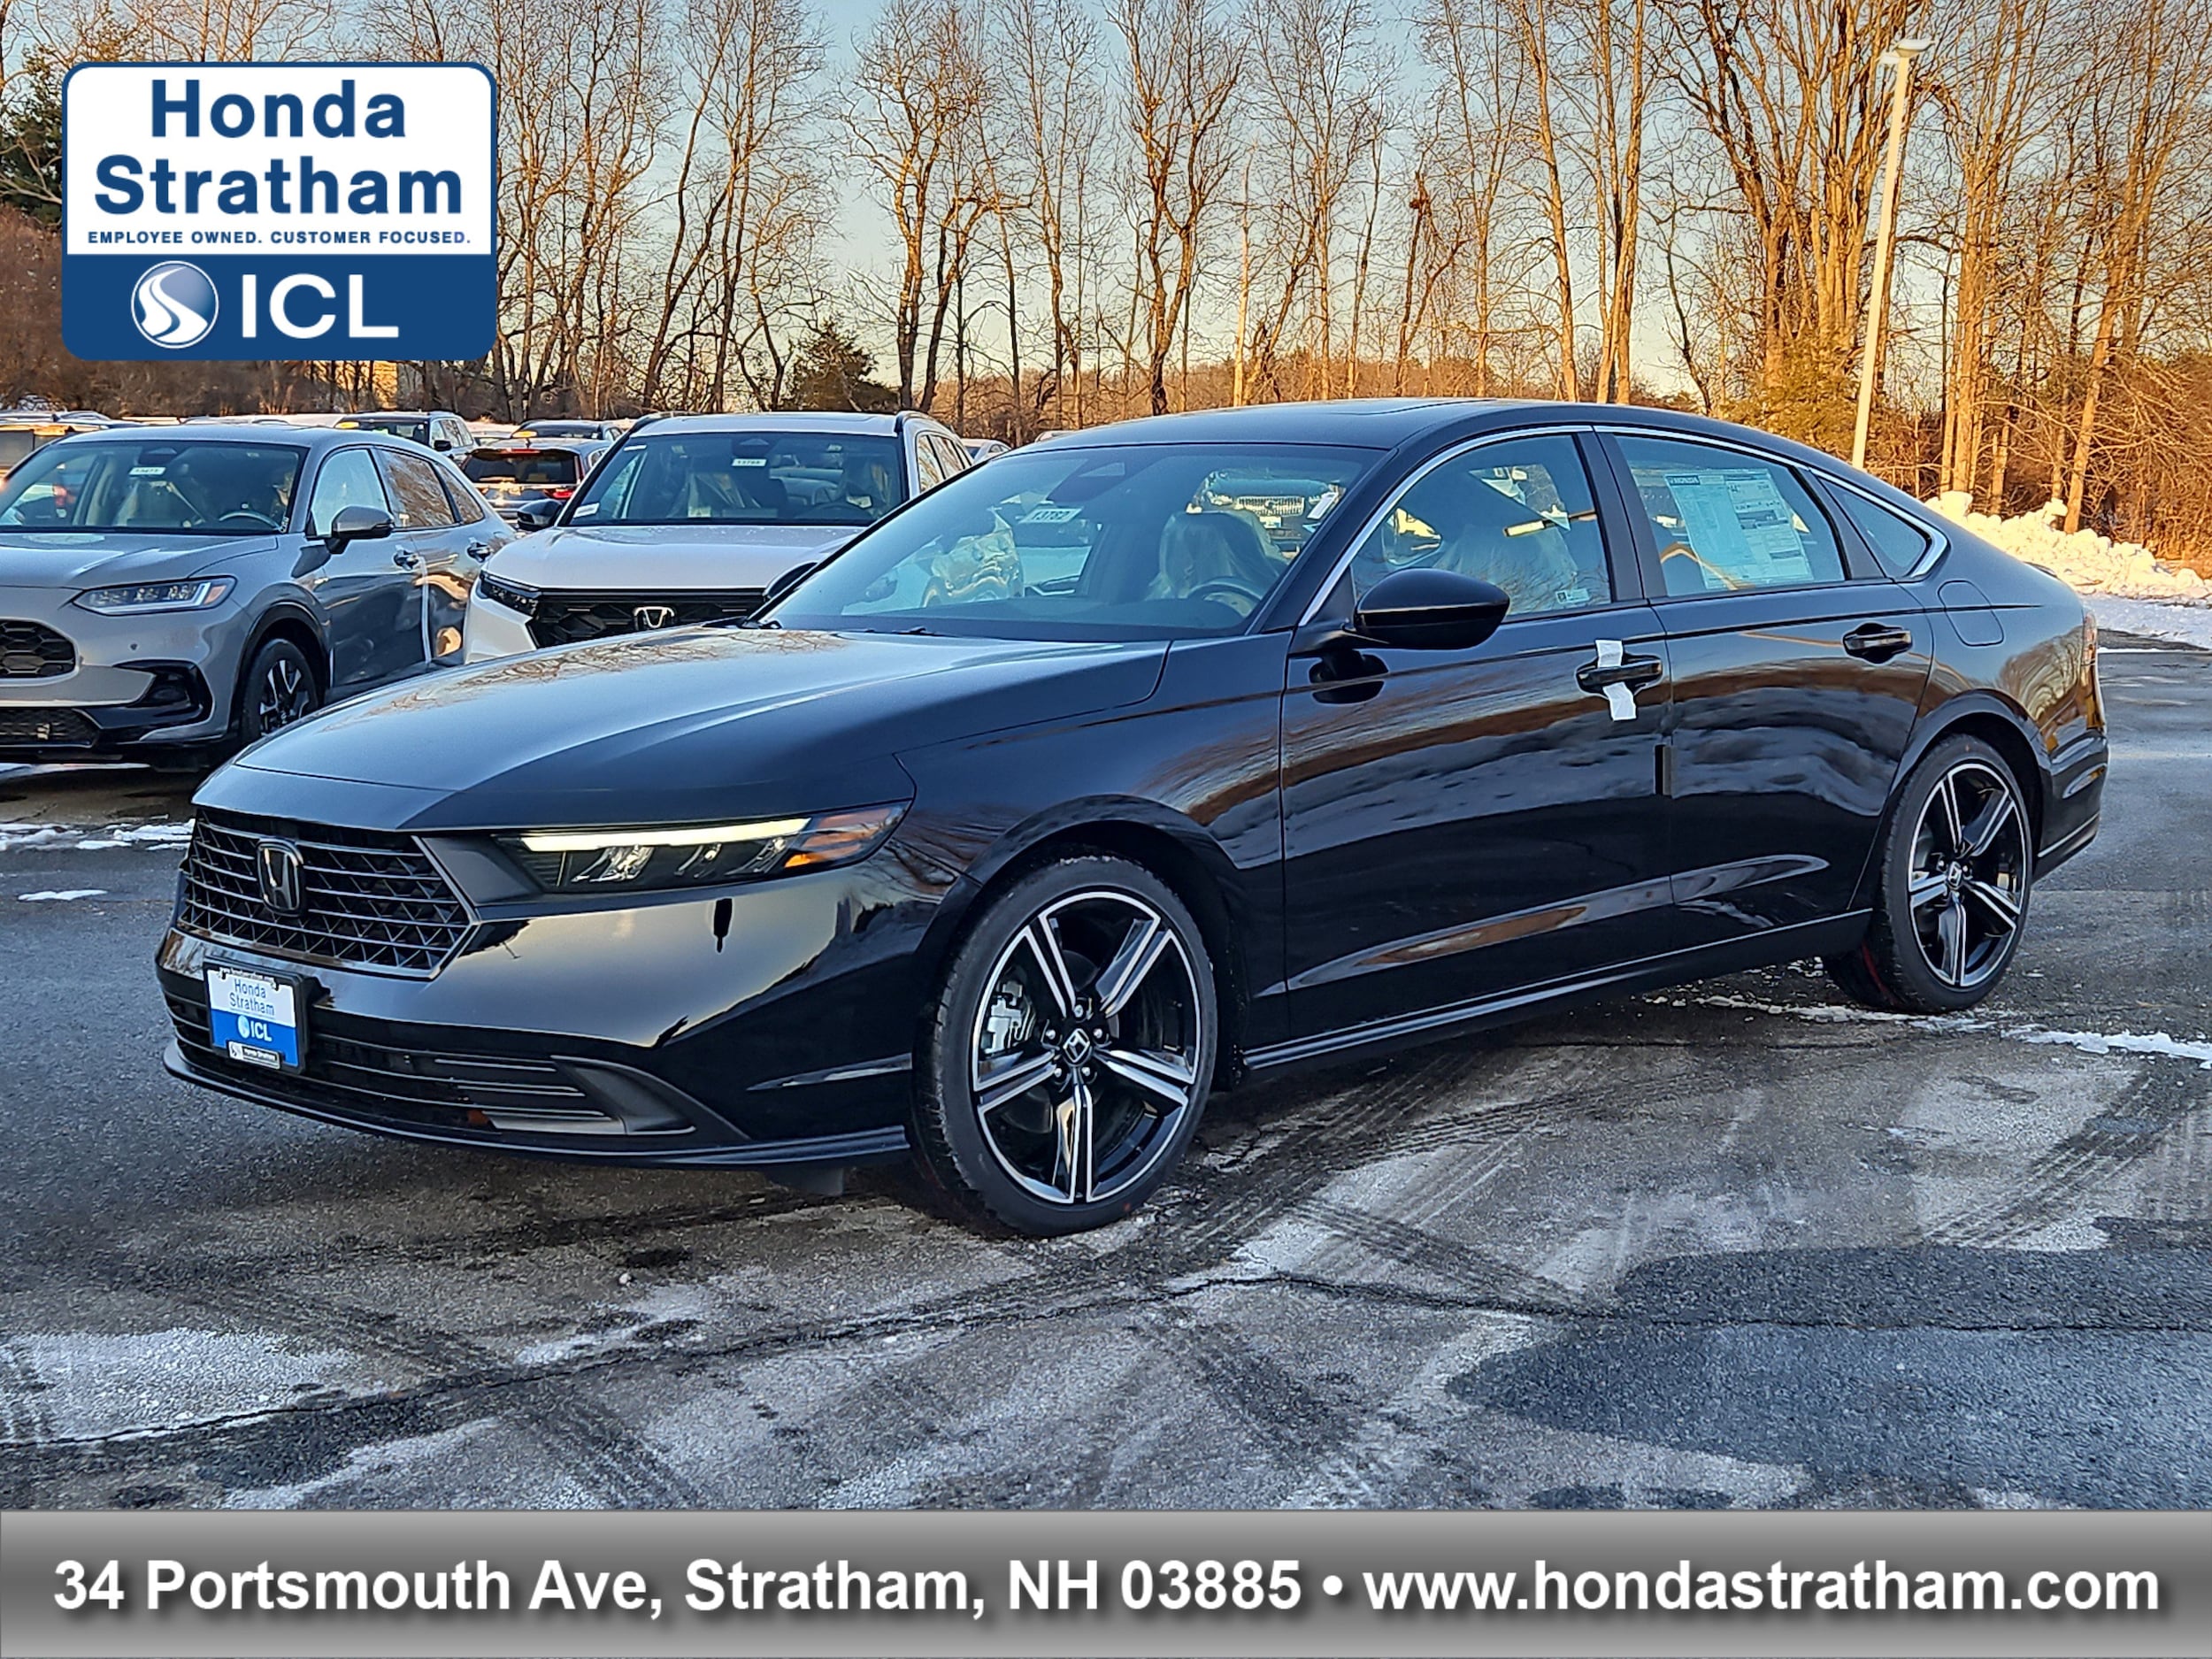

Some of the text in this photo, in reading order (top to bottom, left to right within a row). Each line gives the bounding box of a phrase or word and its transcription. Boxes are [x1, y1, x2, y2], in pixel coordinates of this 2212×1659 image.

[234, 979, 266, 999] Honda
[229, 992, 275, 1016] Stratham
[250, 1020, 273, 1042] ICL
